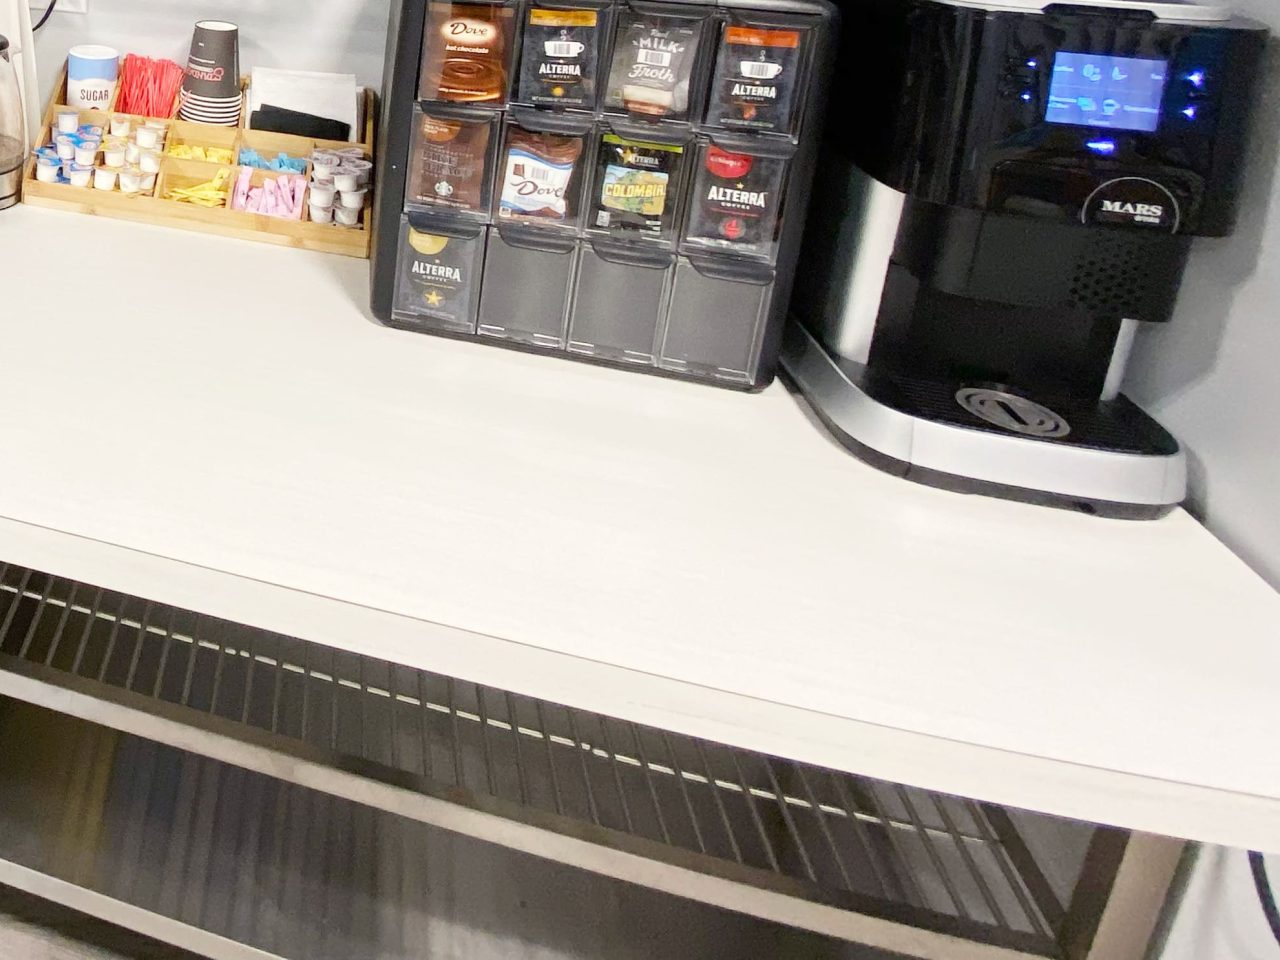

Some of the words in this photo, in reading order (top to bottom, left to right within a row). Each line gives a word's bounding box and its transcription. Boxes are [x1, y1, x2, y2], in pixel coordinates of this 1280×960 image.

[450, 22, 488, 36] Dove
[639, 38, 678, 53] MILK
[539, 63, 581, 76] ALTERRA
[628, 64, 675, 82] Froth
[80, 89, 109, 102] SUGAR
[731, 84, 776, 99] ALTERRA
[510, 180, 564, 197] Dove
[605, 183, 666, 198] COLOMBIA
[707, 186, 767, 208] ALTERRA
[1101, 200, 1163, 216] MARS
[412, 260, 463, 282] ALTERRA
